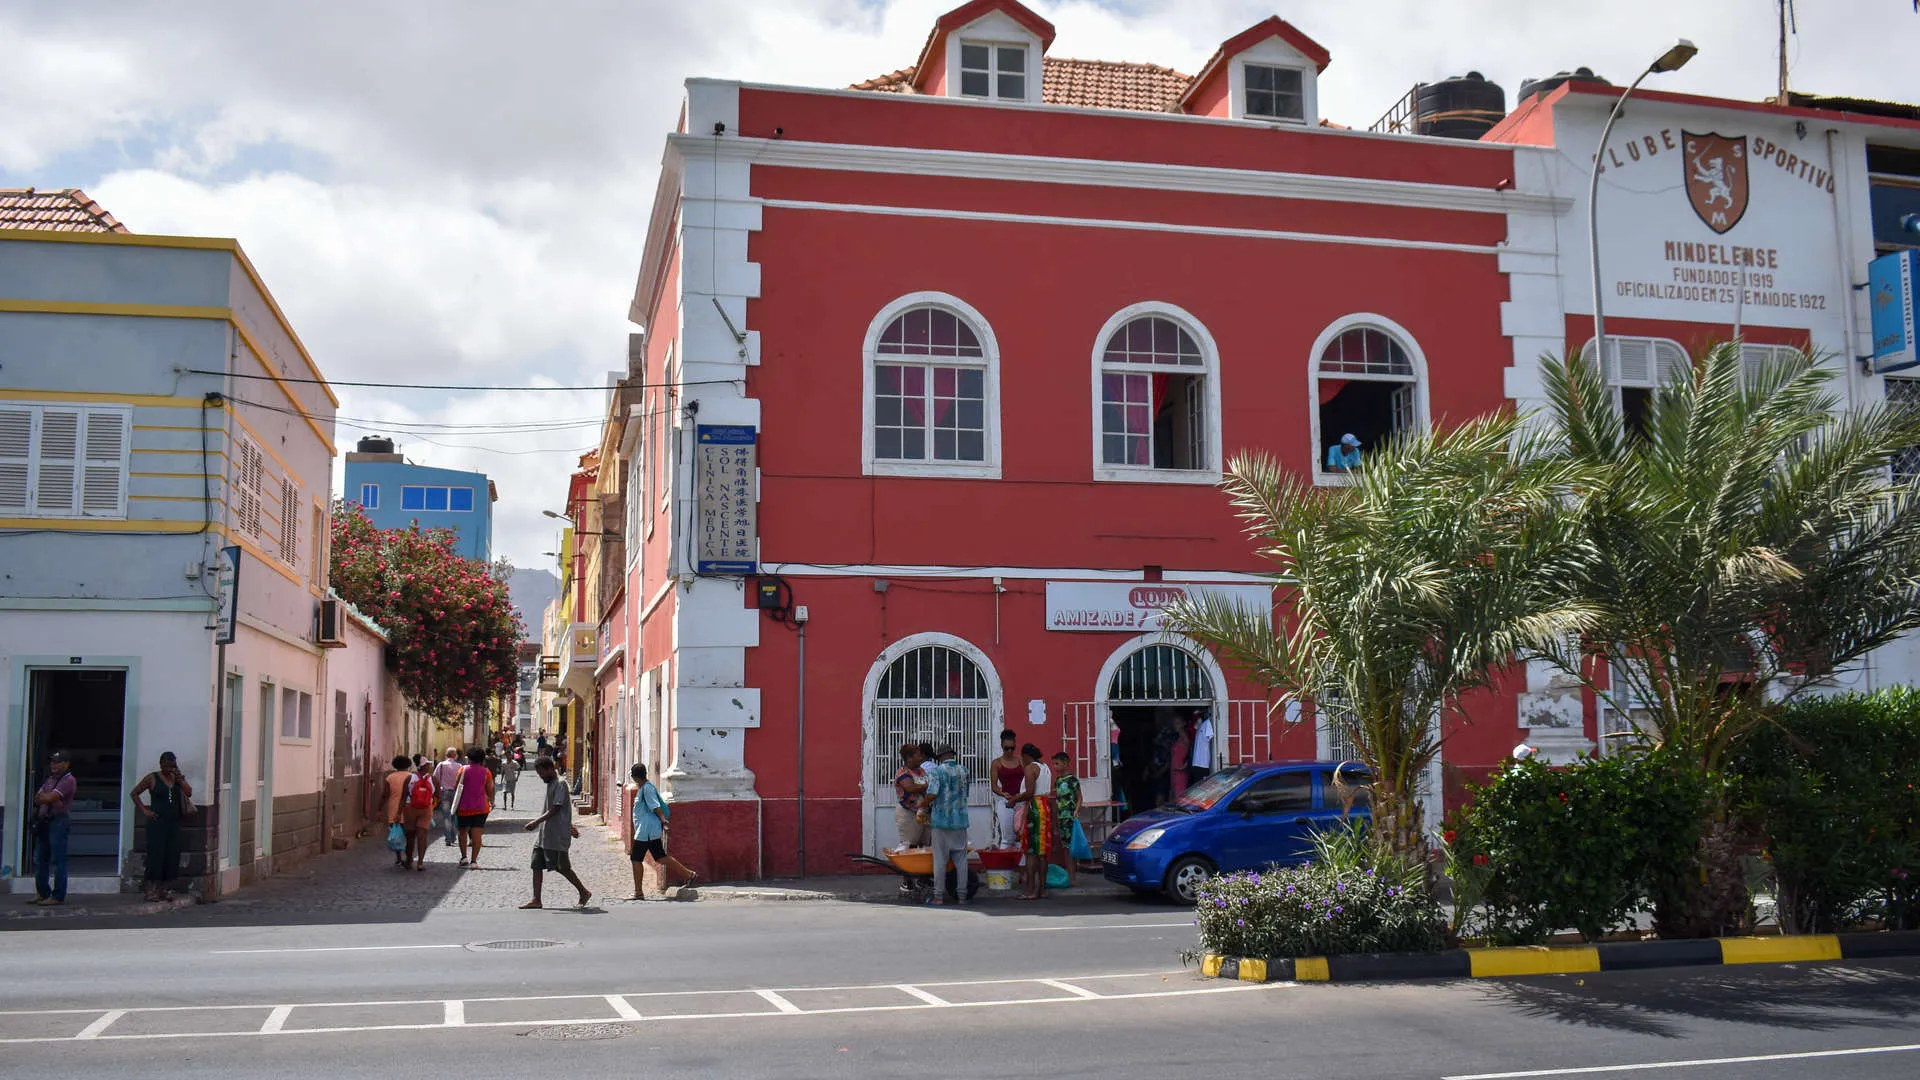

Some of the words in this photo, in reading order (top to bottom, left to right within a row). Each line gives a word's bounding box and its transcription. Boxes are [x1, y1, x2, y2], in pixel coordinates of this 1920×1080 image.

[1752, 137, 1834, 194] SPORTIVO
[1711, 211, 1727, 226] M
[1664, 240, 1778, 269] MINDELENSE
[1673, 267, 1729, 286] FUNDADO
[1749, 272, 1774, 289] 1919
[1616, 280, 1699, 301] OFICIALIZADO
[1701, 287, 1717, 302] EM
[1719, 289, 1735, 304] 25
[1753, 291, 1780, 307] MAIO
[1782, 293, 1797, 308] DE
[1799, 294, 1827, 311] 1922
[719, 447, 730, 474] SOL
[719, 483, 730, 557] NASCENTE
[1053, 609, 1134, 627] AMIZADE
